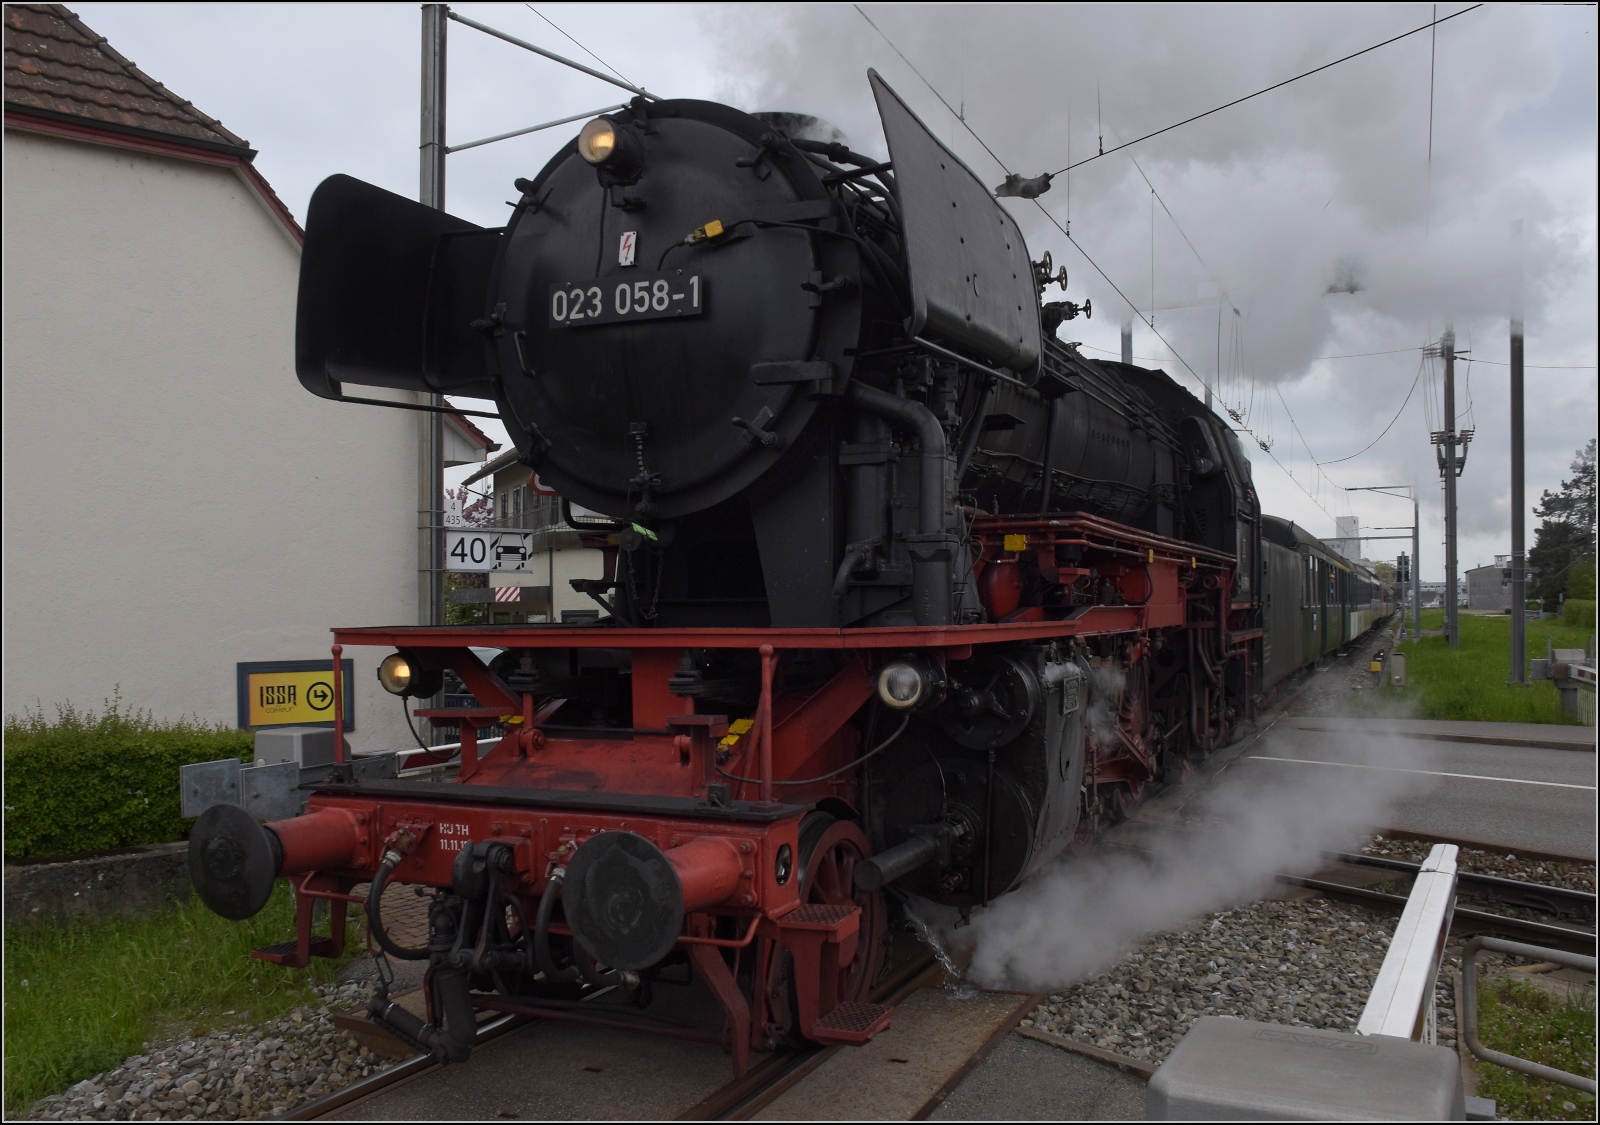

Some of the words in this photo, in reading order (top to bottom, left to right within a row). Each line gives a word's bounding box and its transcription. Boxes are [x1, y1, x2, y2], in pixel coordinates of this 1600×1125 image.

[552, 286, 602, 321] 023
[615, 275, 699, 315] 058-1
[450, 501, 456, 511] 4
[445, 515, 461, 525] 435
[450, 537, 487, 564] 40
[259, 685, 297, 708] ISSA
